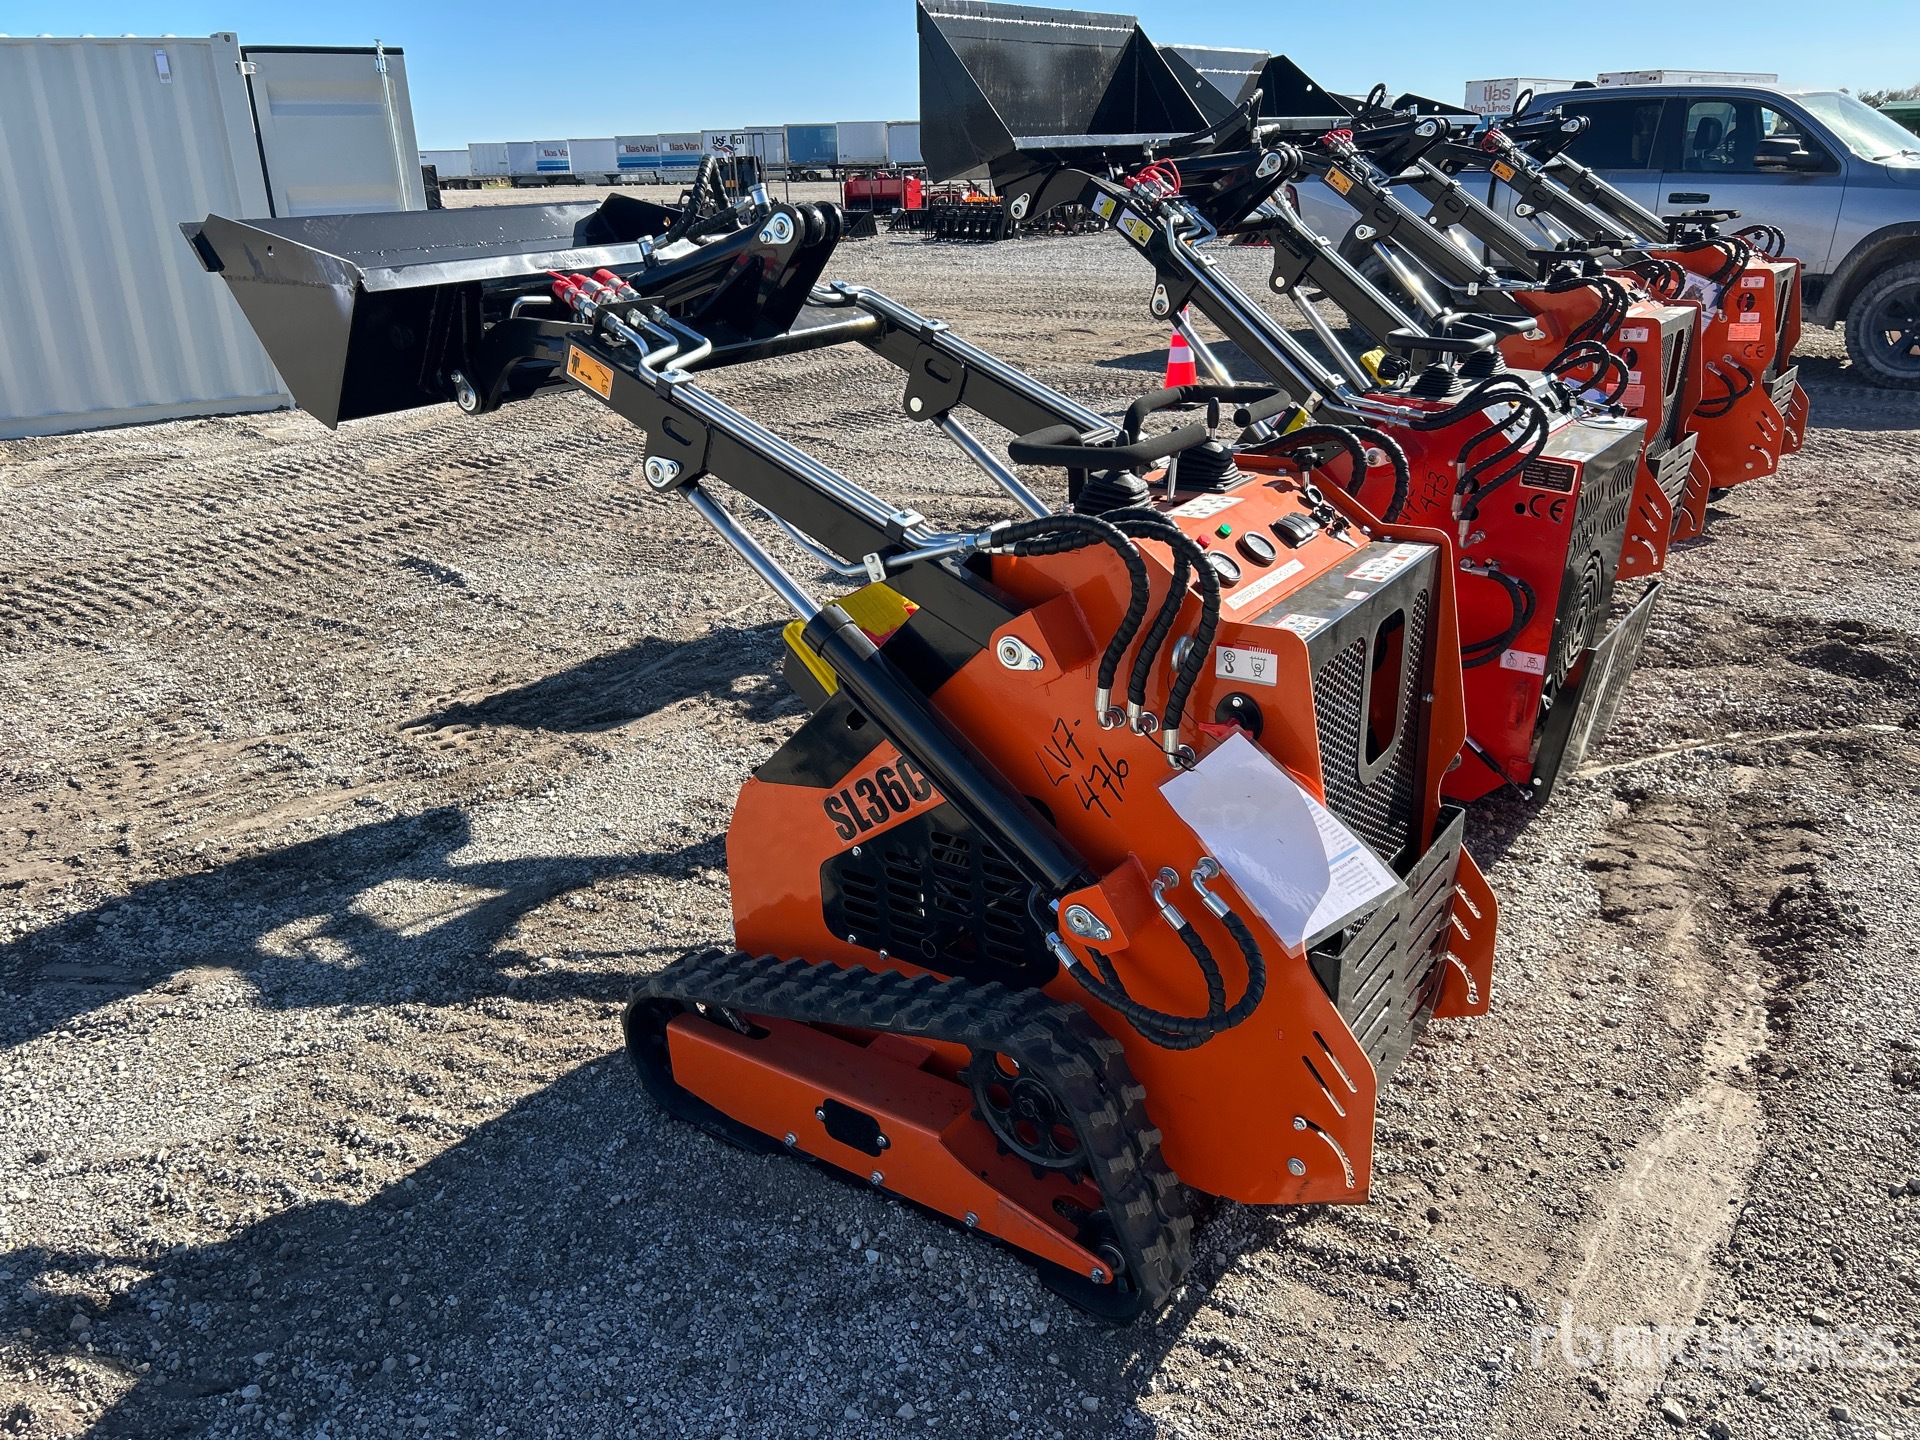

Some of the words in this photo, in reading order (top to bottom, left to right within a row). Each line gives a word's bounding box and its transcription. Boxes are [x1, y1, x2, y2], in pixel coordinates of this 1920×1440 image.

[1471, 104, 1486, 113] Van
[1487, 102, 1511, 113] Lines
[684, 142, 700, 151] Van
[712, 135, 726, 147] USF
[640, 144, 656, 152] Van
[1529, 493, 1567, 523] CE
[1075, 747, 1129, 818] 476
[823, 756, 932, 841] SL36C
